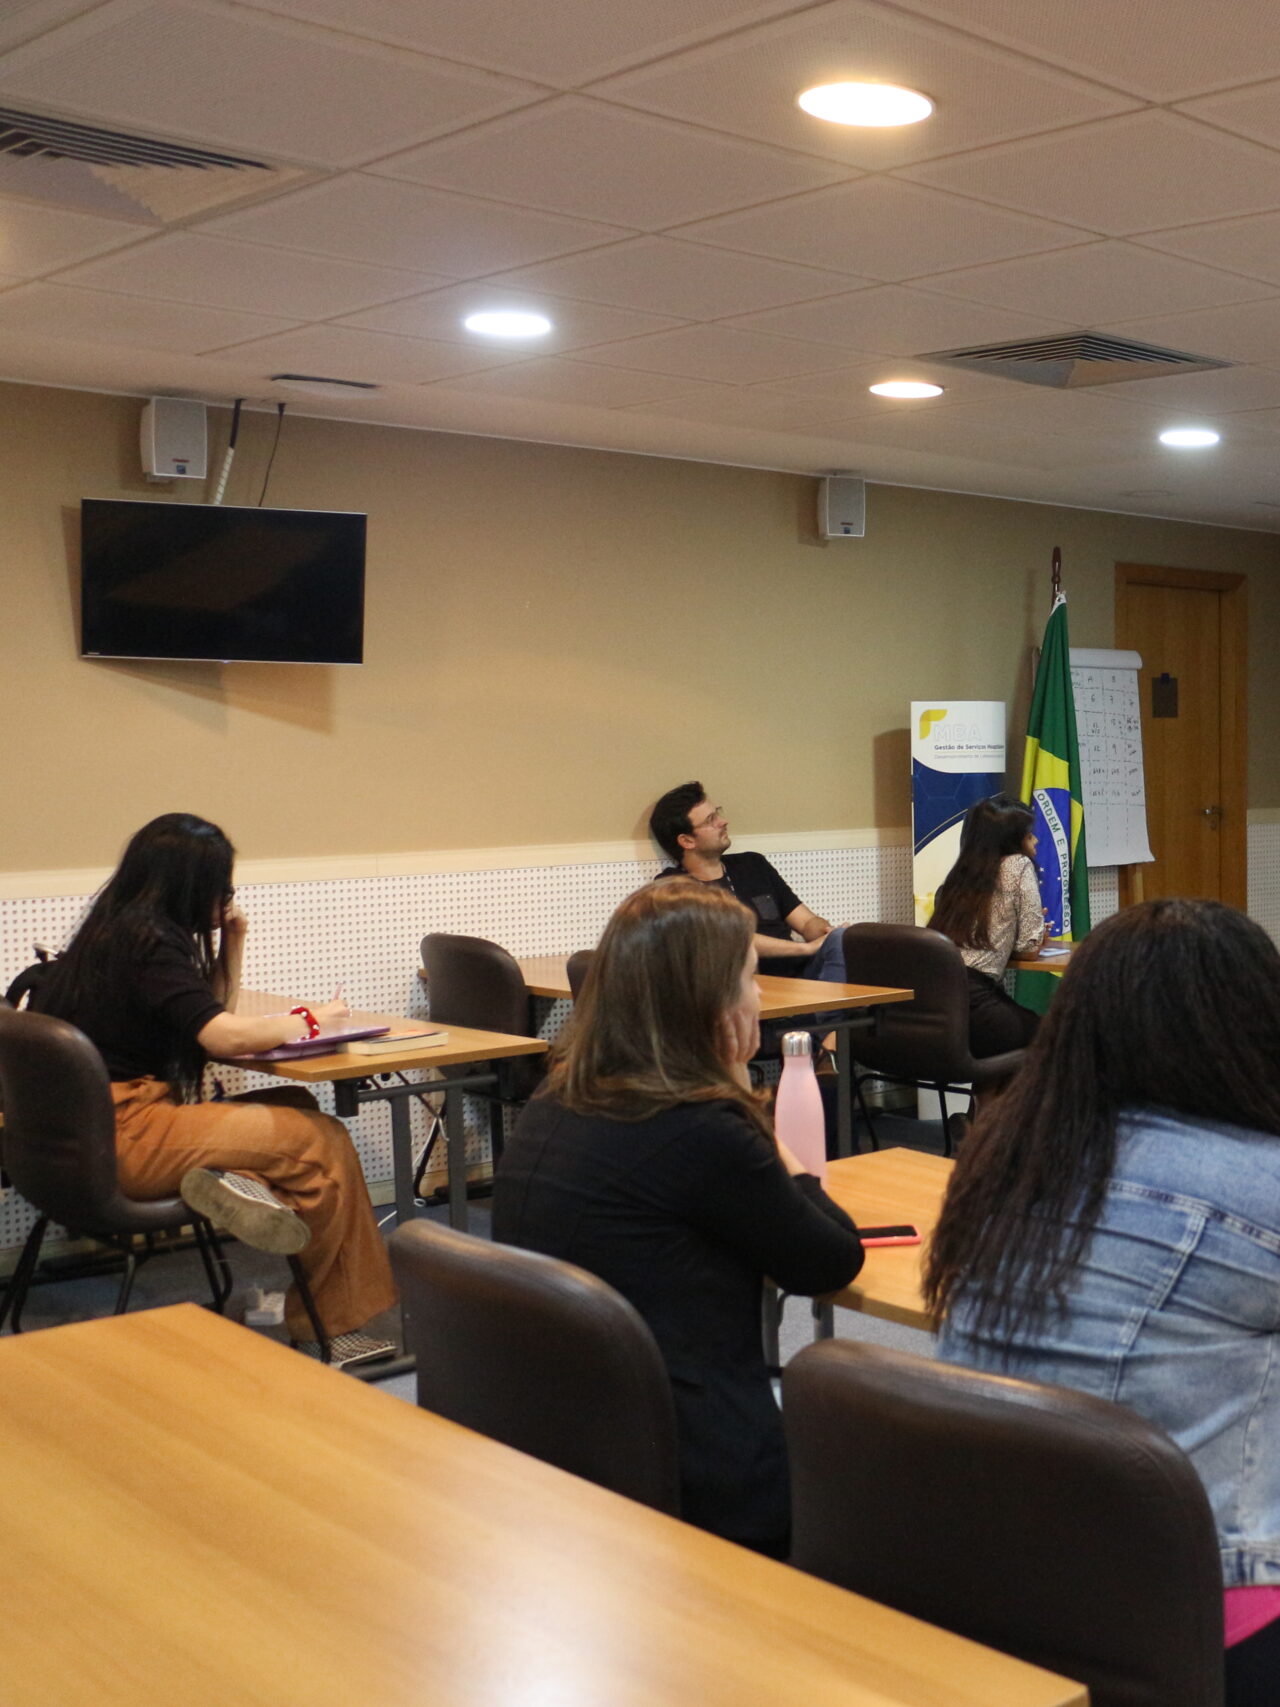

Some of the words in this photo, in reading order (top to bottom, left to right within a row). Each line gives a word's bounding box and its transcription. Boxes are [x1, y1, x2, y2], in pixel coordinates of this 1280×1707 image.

[933, 723, 982, 742] MBA
[1037, 793, 1061, 833] ORDEM
[1056, 839, 1066, 847] E
[1060, 853, 1070, 928] PROGRESSO
